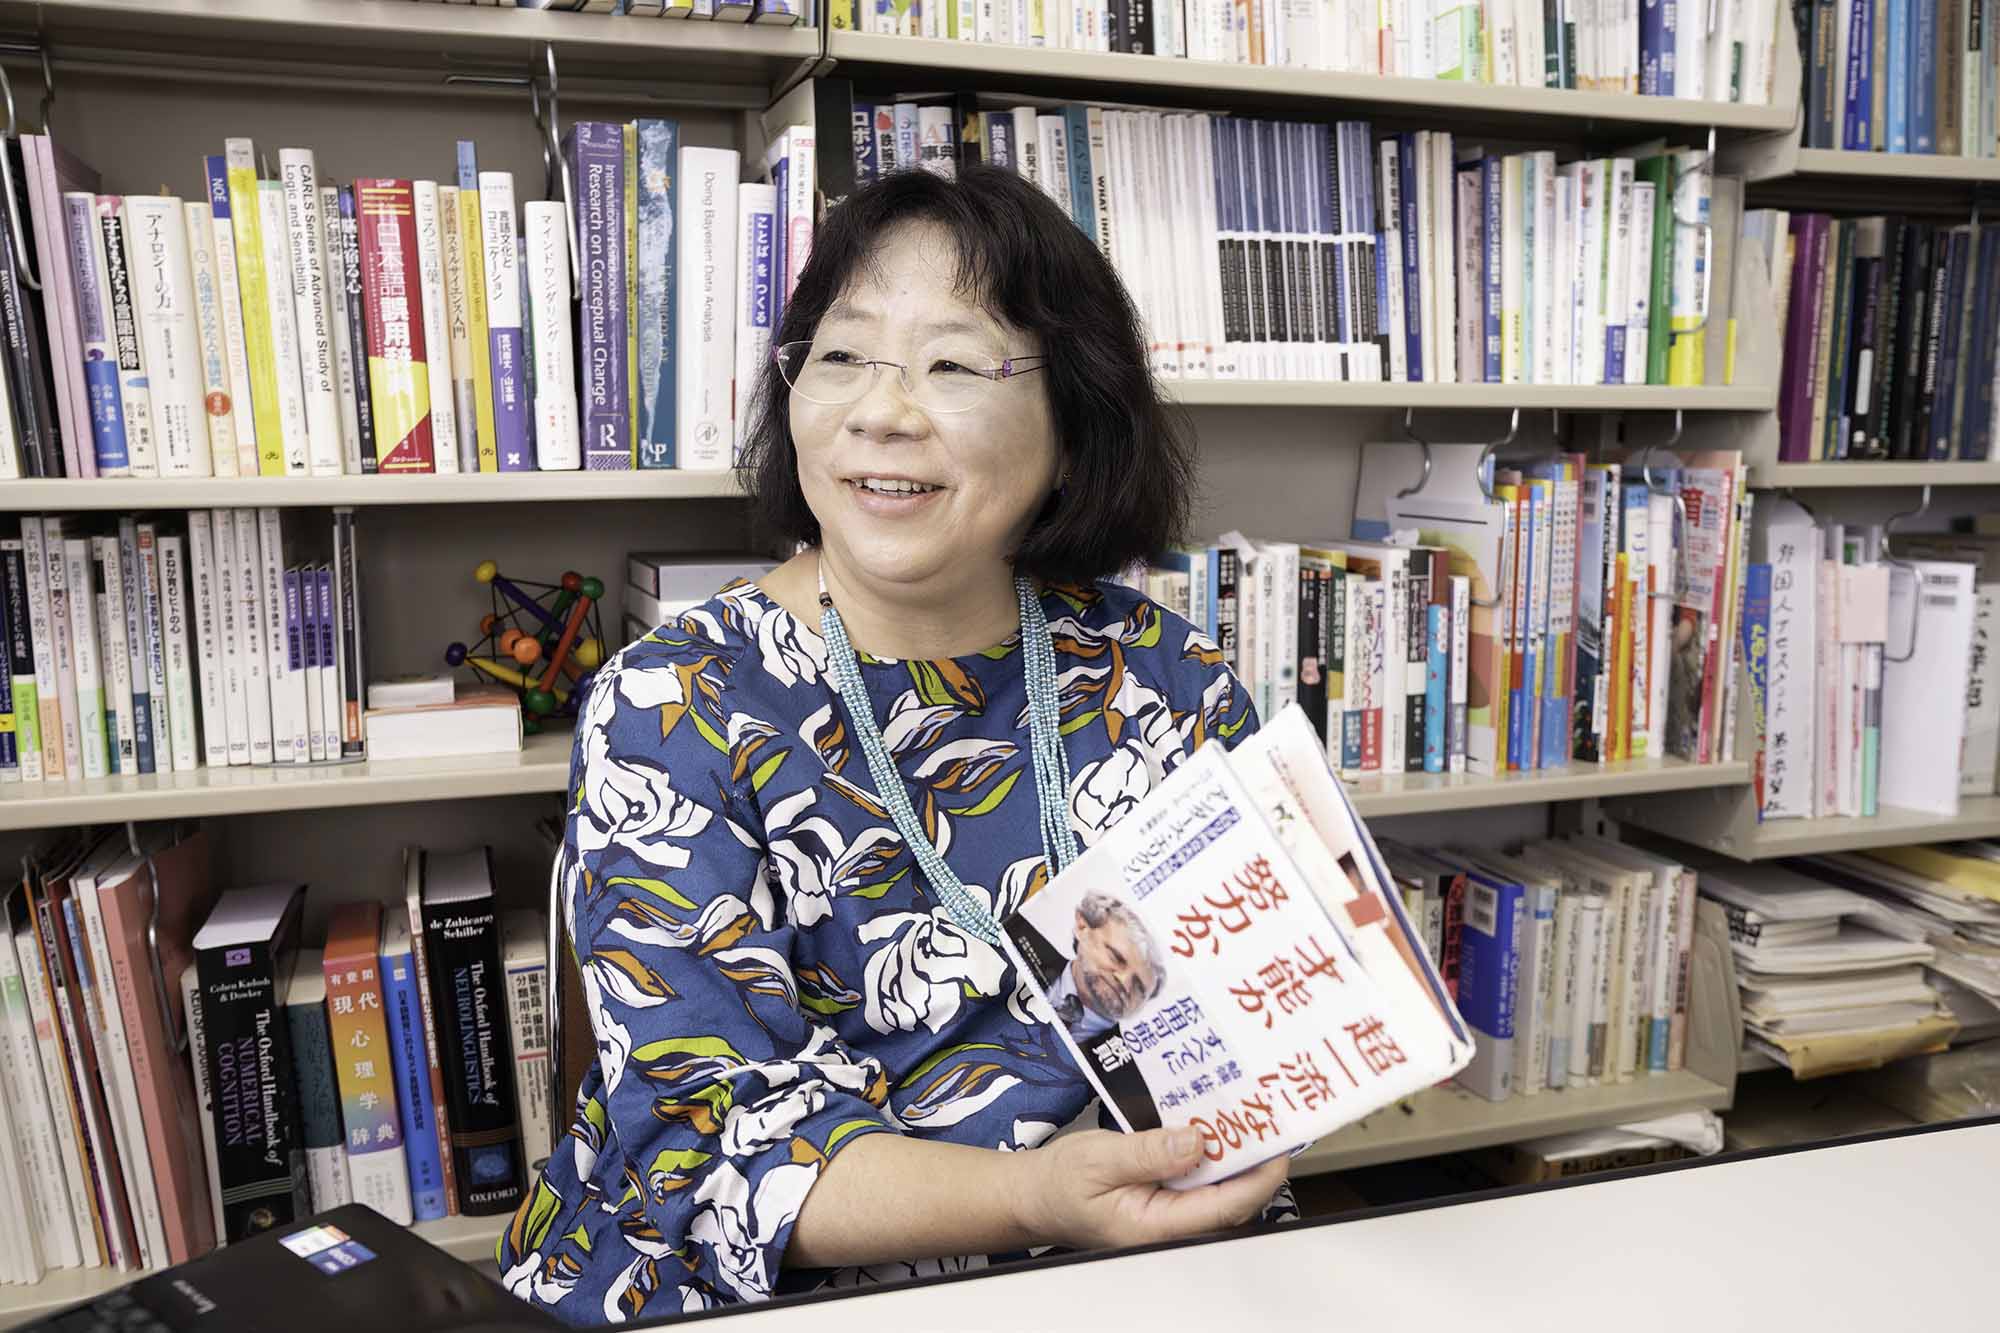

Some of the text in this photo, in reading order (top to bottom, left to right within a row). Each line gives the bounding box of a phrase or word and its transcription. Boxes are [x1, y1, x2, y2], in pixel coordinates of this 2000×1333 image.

[147, 213, 171, 310] アナロジーの力
[285, 164, 306, 297] Logic and Sensibility
[300, 164, 332, 392] CARLS Series of Advanced Study of
[487, 210, 503, 301] コミュニケーション
[499, 210, 513, 269] 言語文化と
[543, 215, 558, 342] マインドワンダリング
[702, 171, 716, 343] Doing Bayesian Data Analysis
[756, 216, 770, 324] ことばをつくる
[103, 218, 138, 370] 子どもたちの言語獲得
[447, 235, 466, 340] スキルサイエンス入門
[589, 164, 607, 405] Research on Conceptual Change
[1374, 588, 1385, 675] コーパス
[443, 925, 484, 940] Schiller
[1170, 852, 1292, 958] 努力か?
[209, 981, 236, 994] Cohen
[469, 959, 483, 981] The
[472, 983, 488, 1022] Oxford
[516, 976, 535, 1050] 分類用法辞典
[1227, 935, 1346, 1029] 才能か
[333, 991, 396, 1145] 現代 心理学 辞典
[454, 967, 481, 1106] NEUROLINGUISTICS
[478, 1026, 496, 1090] Handbook
[1093, 996, 1205, 1073] 応用可能の鉄則
[1161, 1026, 1228, 1073] すべてに
[217, 1041, 241, 1146] COGNITION
[240, 1037, 258, 1145] NUMERICAL
[255, 1008, 283, 1167] The Oxford Handbook of
[1189, 1014, 1408, 1163] 超一流になるの
[469, 1186, 518, 1203] OXFORD
